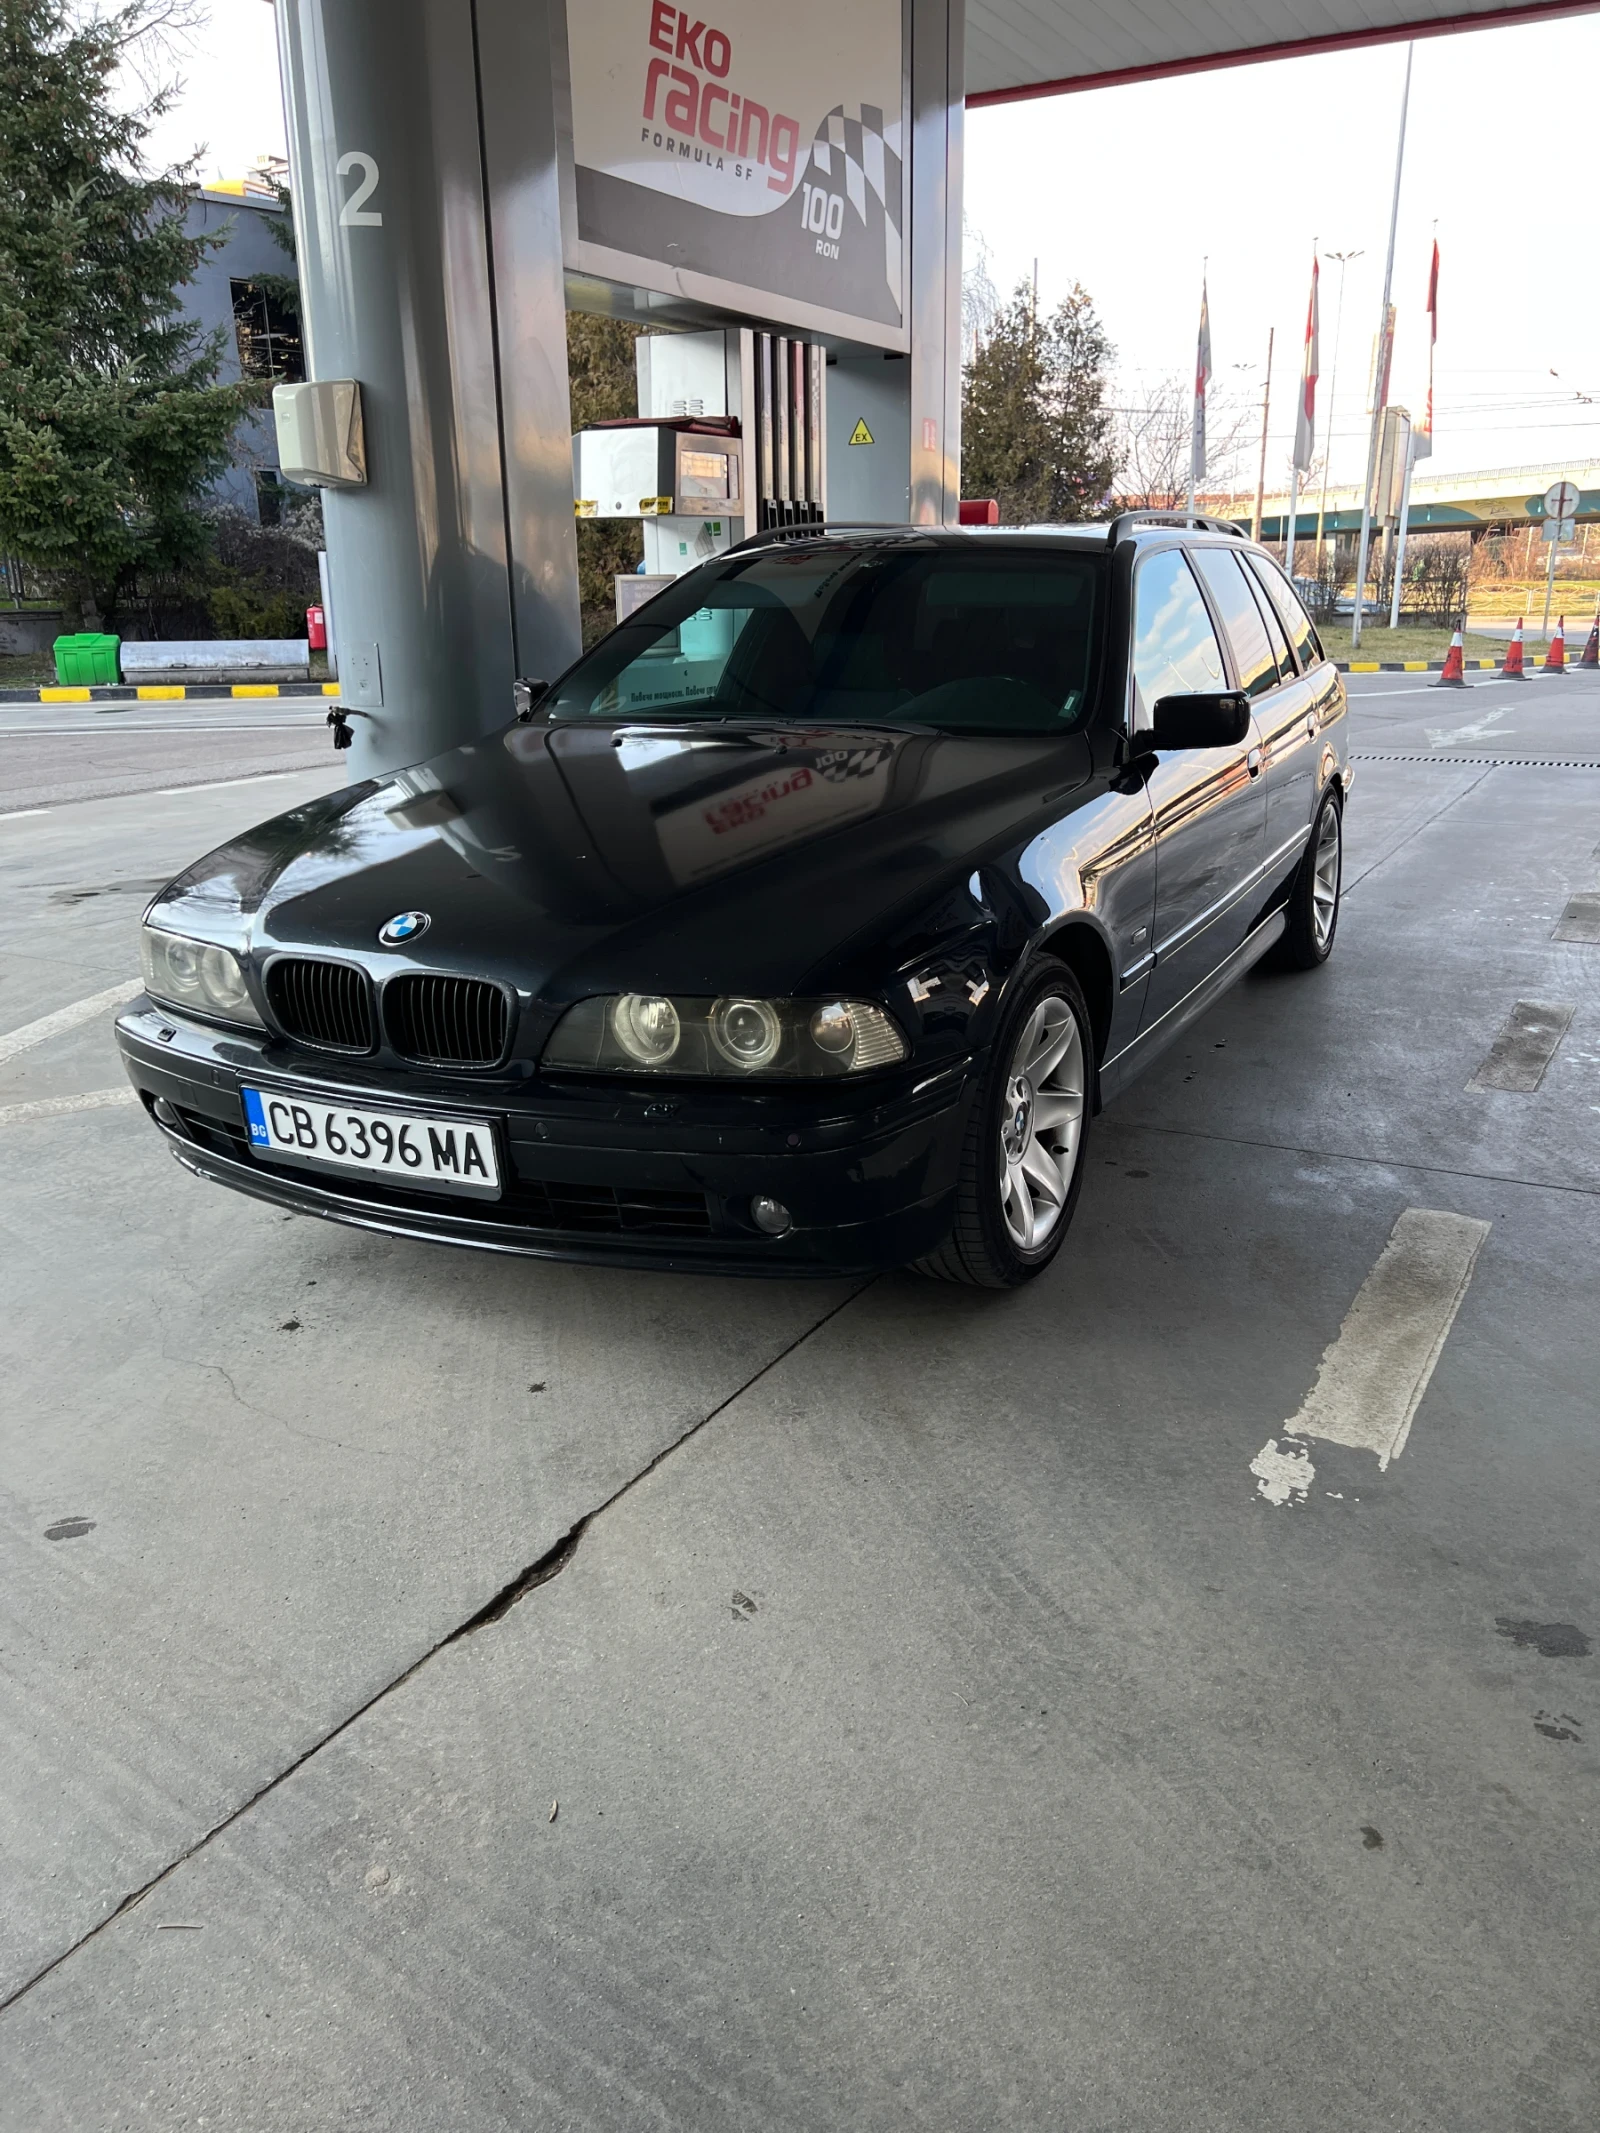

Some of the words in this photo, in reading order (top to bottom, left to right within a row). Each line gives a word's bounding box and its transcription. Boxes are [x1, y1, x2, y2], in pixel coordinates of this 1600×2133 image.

[649, 0, 732, 79] EKO
[641, 128, 725, 172] FORMULA
[735, 164, 754, 181] SF
[643, 57, 800, 195] racing
[336, 151, 383, 227] 2
[801, 182, 845, 240] 100
[815, 239, 840, 260] RON
[855, 433, 868, 442] EX
[251, 1123, 267, 1138] BG
[268, 1101, 318, 1149] CB
[325, 1112, 422, 1168] 6396
[427, 1126, 489, 1178] MA
